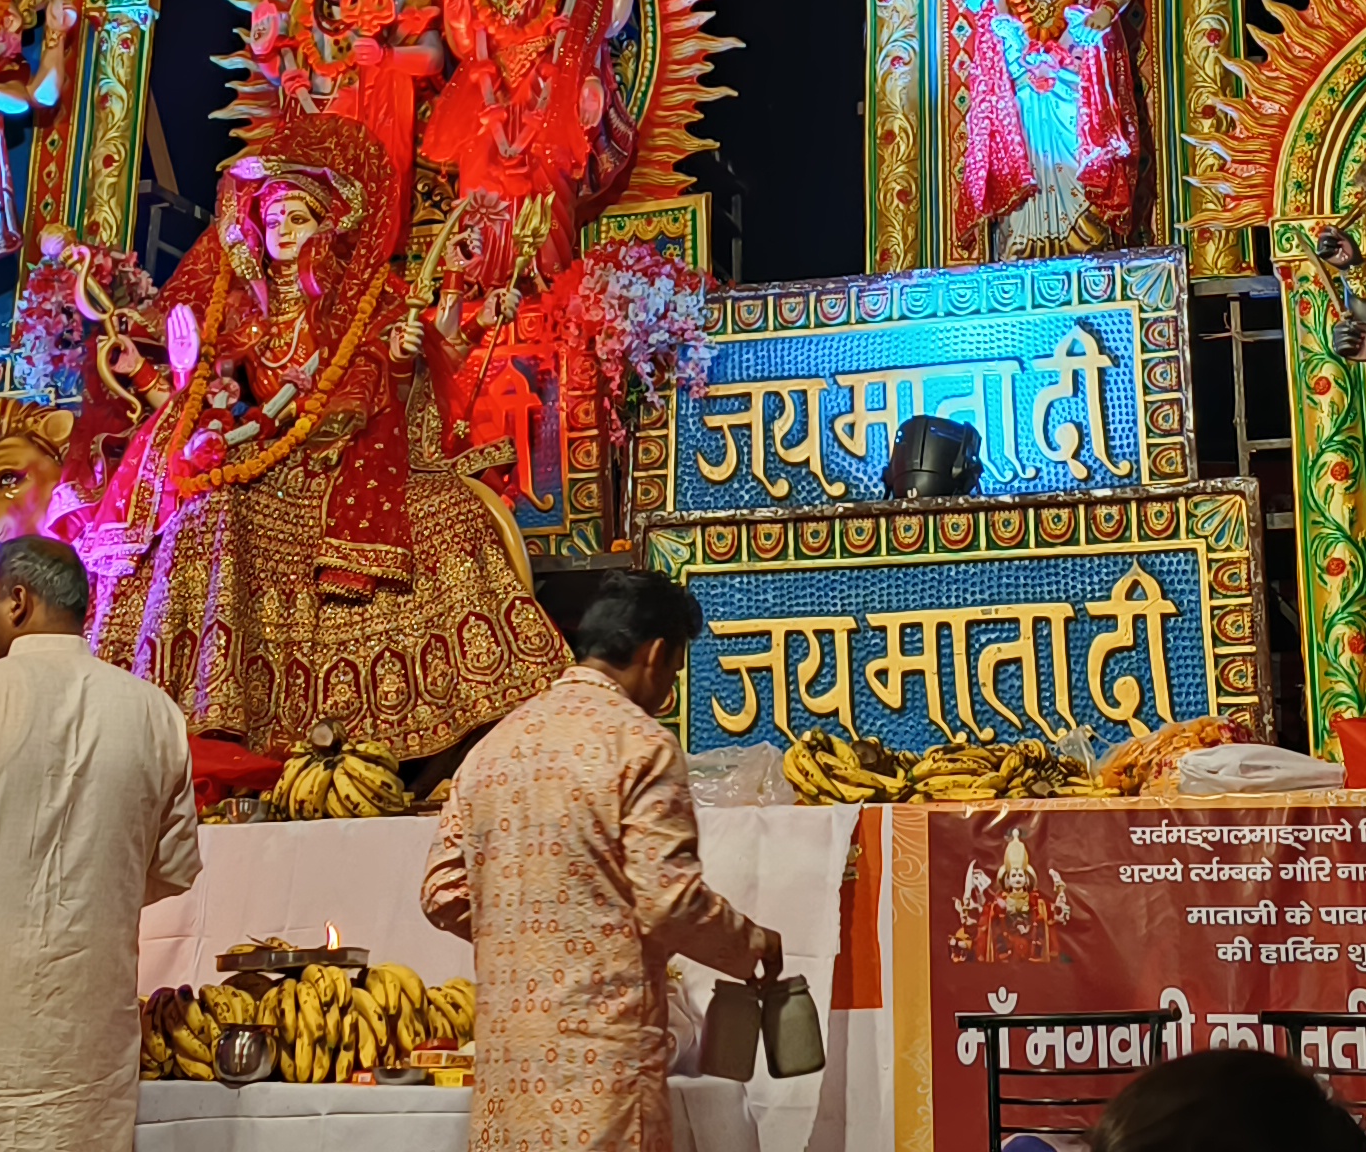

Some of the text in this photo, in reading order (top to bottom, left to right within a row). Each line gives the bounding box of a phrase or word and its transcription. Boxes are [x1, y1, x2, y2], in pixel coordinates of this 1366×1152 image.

[696, 323, 1132, 498] जय माता दी
[708, 560, 1180, 744] जय माता दी
[1118, 858, 1183, 883] शरण्ये
[1279, 856, 1332, 882] गौरि
[1186, 899, 1278, 925] माताजी
[1284, 900, 1314, 925] के
[1215, 936, 1253, 962] की
[1259, 936, 1341, 964] हार्दिक
